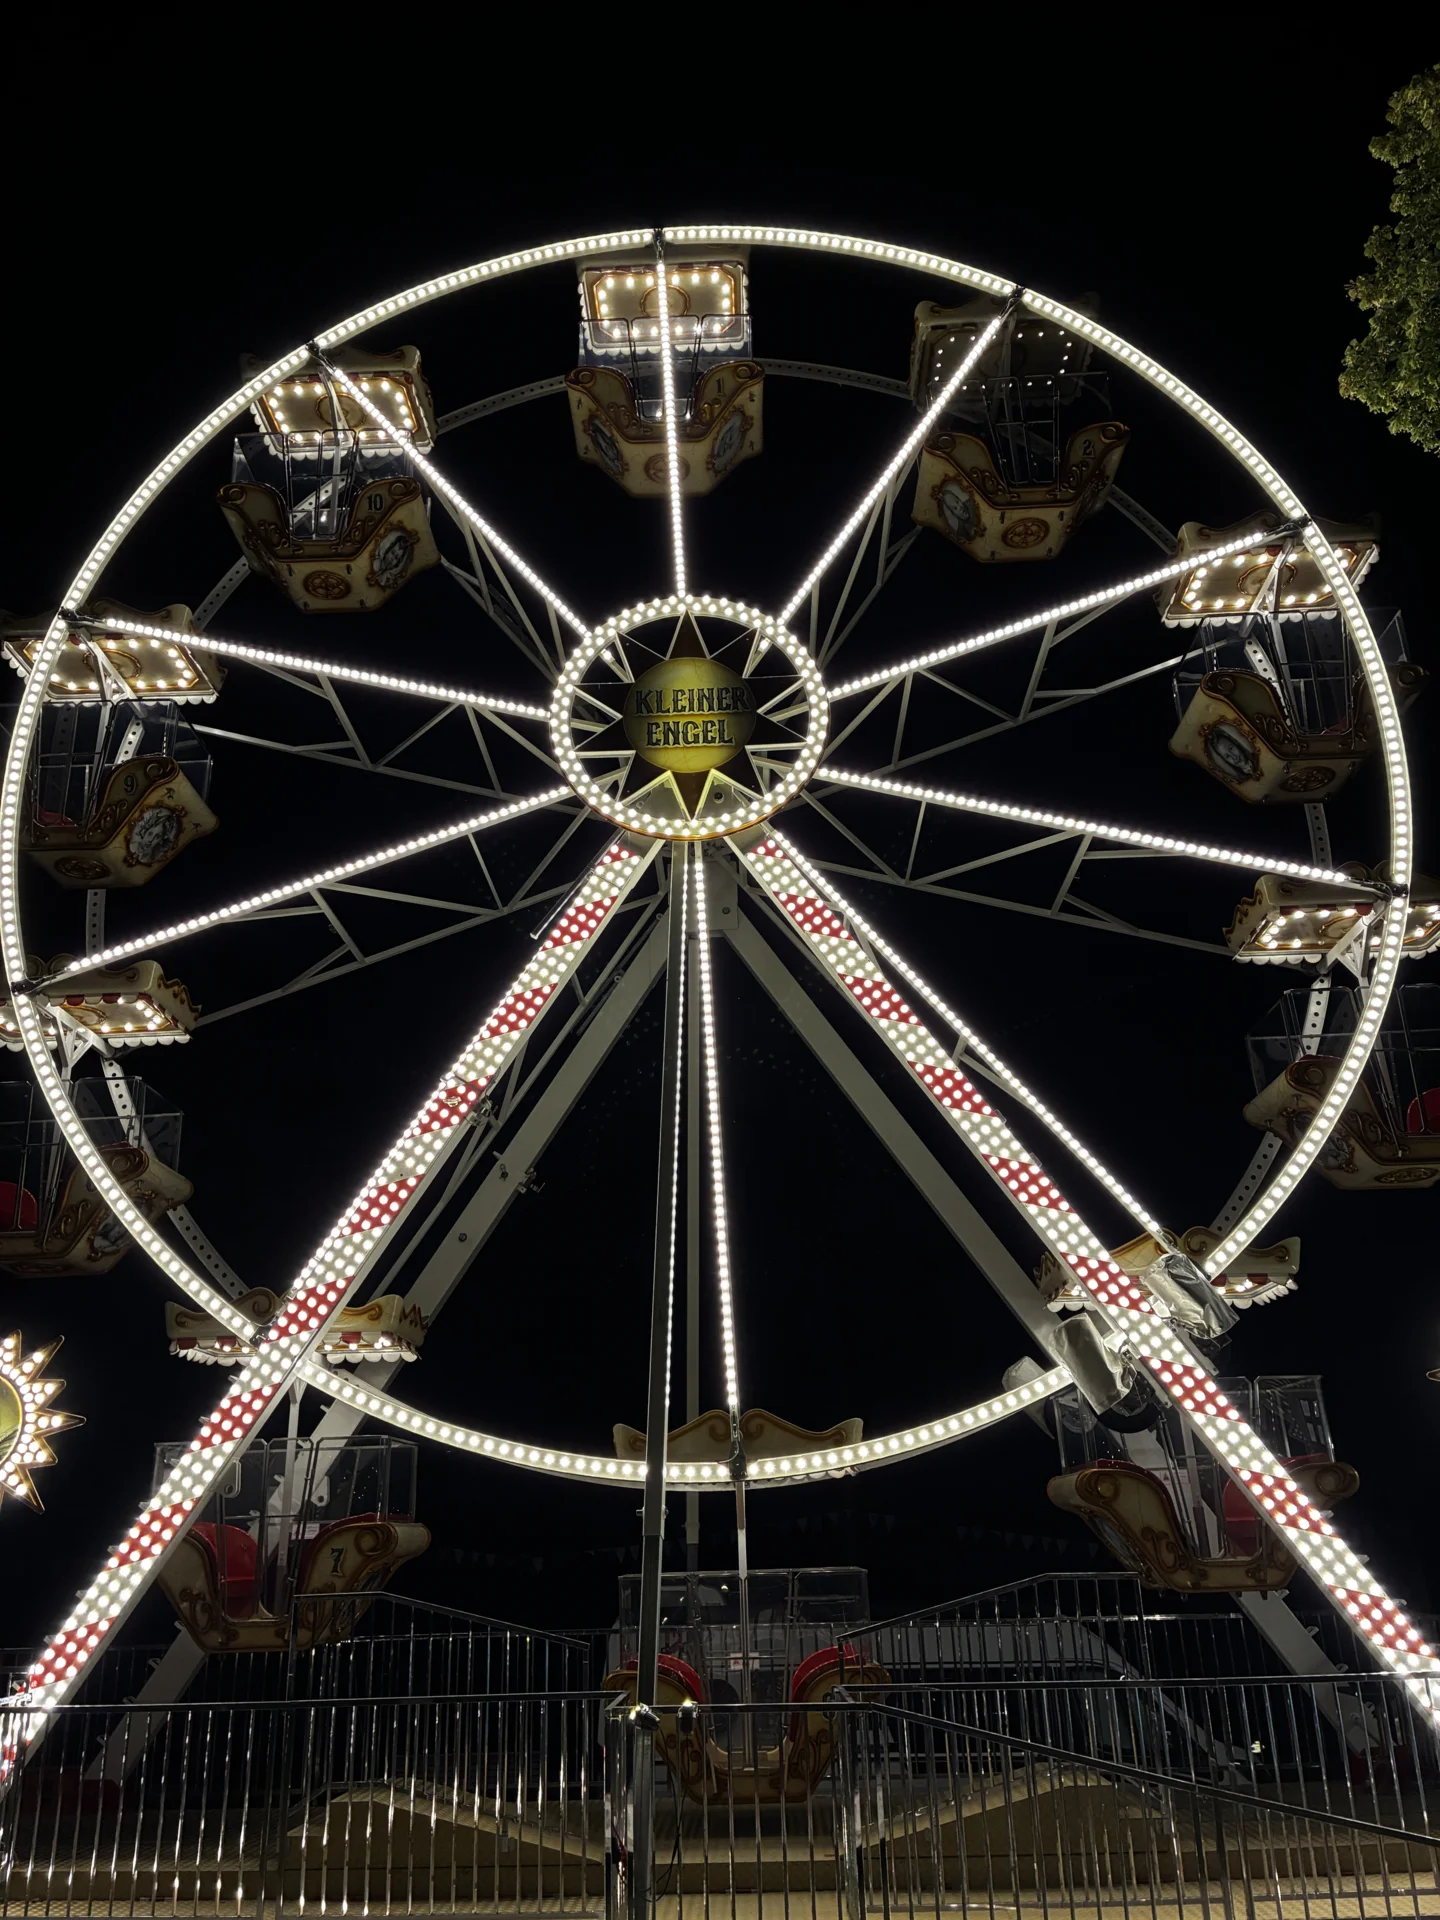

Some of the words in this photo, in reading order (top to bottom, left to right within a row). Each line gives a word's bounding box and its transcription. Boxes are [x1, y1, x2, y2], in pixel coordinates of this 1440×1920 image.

[1082, 439, 1095, 459] 2
[367, 493, 384, 512] 10
[635, 687, 750, 715] KLEINER
[646, 719, 734, 747] ENGEL
[123, 774, 137, 794] 9
[330, 1547, 346, 1576] 7
